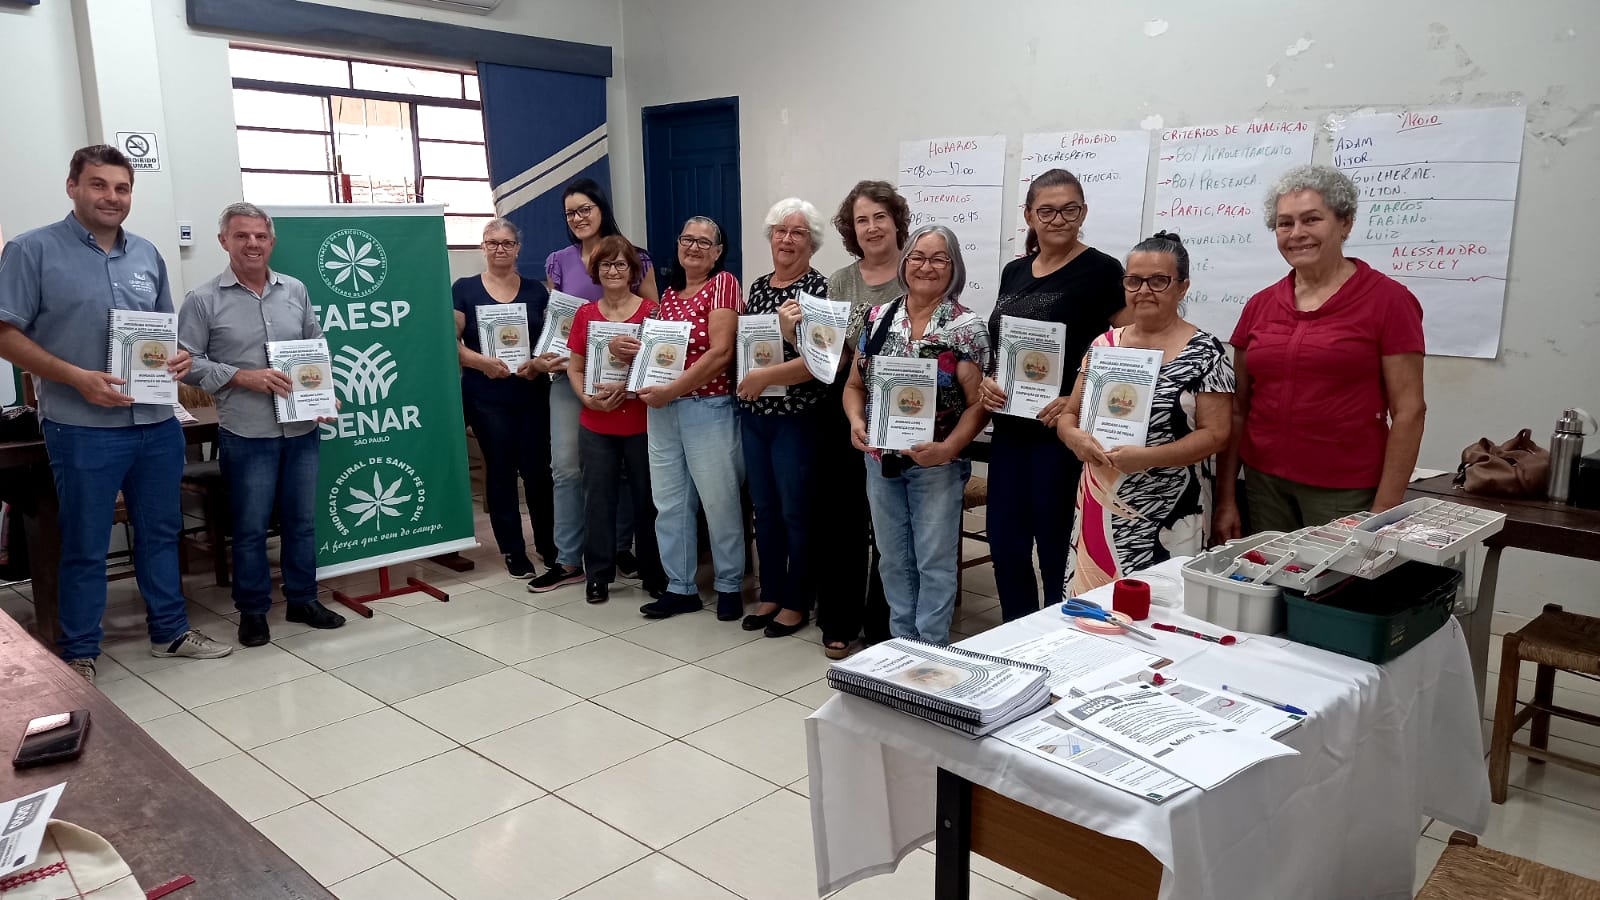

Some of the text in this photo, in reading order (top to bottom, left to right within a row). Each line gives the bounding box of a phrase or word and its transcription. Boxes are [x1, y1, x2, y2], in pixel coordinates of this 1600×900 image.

[1225, 125, 1239, 134] DE
[1036, 150, 1097, 162] DESRESPEITO
[1369, 201, 1423, 214] MARCOS
[1366, 229, 1400, 240] LUIZ
[1392, 259, 1459, 271] WESLEY
[318, 405, 422, 441] SENAR
[353, 435, 390, 446] SÃO PAULO
[368, 457, 383, 465] DE
[385, 457, 416, 476] SANTA
[335, 461, 367, 486] RURAL
[417, 489, 426, 503] DO
[329, 487, 350, 536] SINDICATO
[410, 505, 424, 522] SUL
[332, 538, 359, 554] força
[360, 535, 379, 548] que
[380, 532, 398, 541] vem
